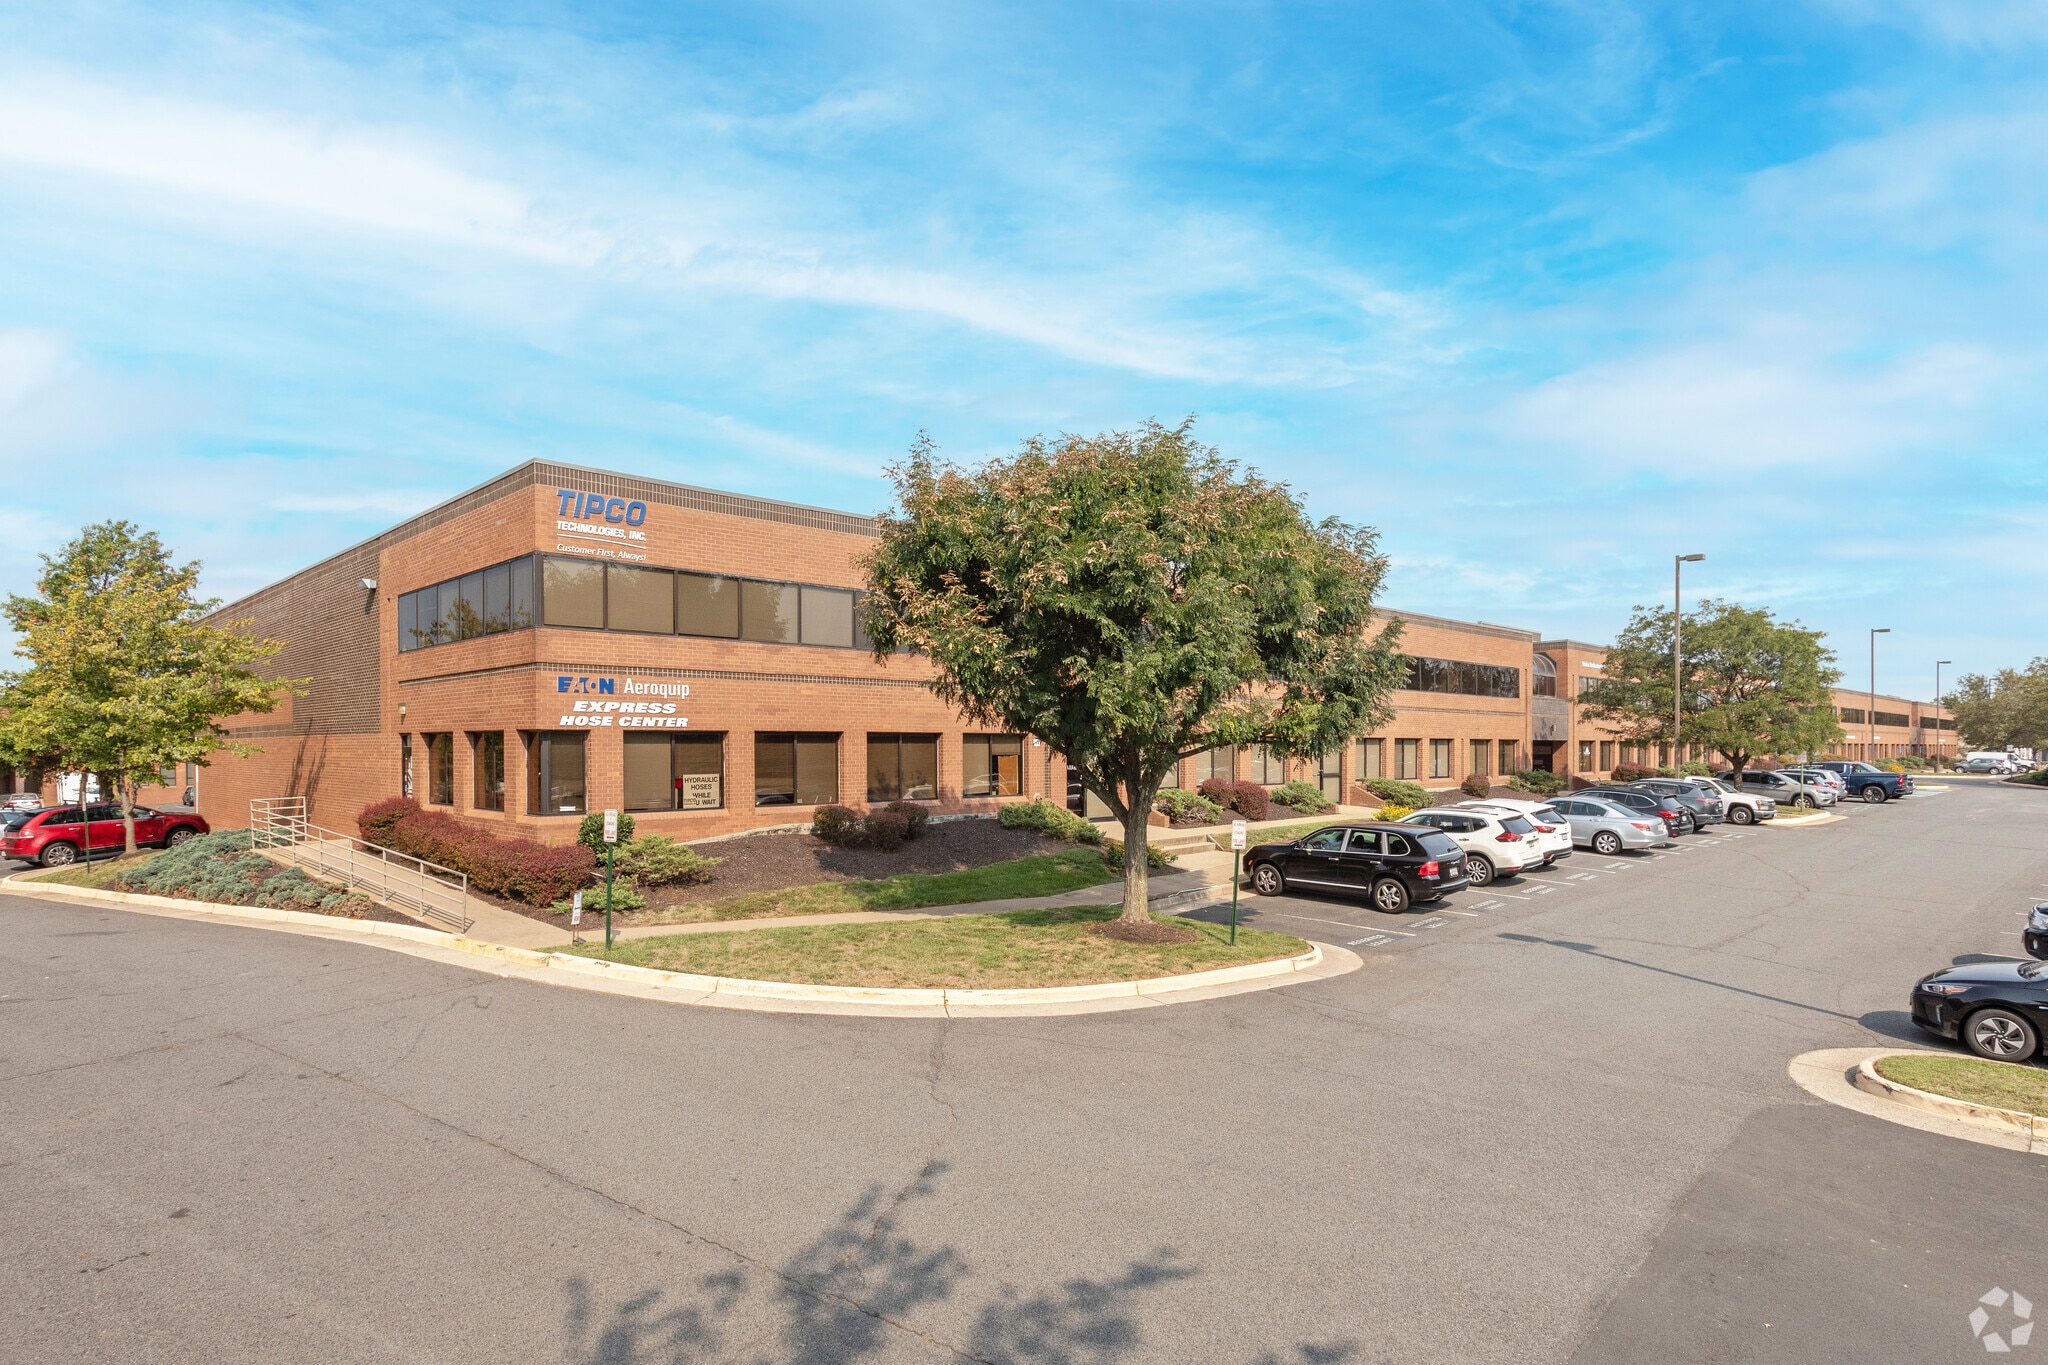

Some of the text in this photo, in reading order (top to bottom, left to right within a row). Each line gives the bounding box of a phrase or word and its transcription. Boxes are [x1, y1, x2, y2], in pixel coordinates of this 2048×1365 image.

[557, 489, 647, 526] TIPCO
[557, 520, 647, 541] TECHNOLOGIES, INC.
[557, 543, 595, 555] Customer
[597, 548, 616, 558] First,
[557, 676, 690, 699] EATON Aeroquip
[573, 701, 677, 714] EXPRESS
[559, 715, 688, 727] HOSE CENTER
